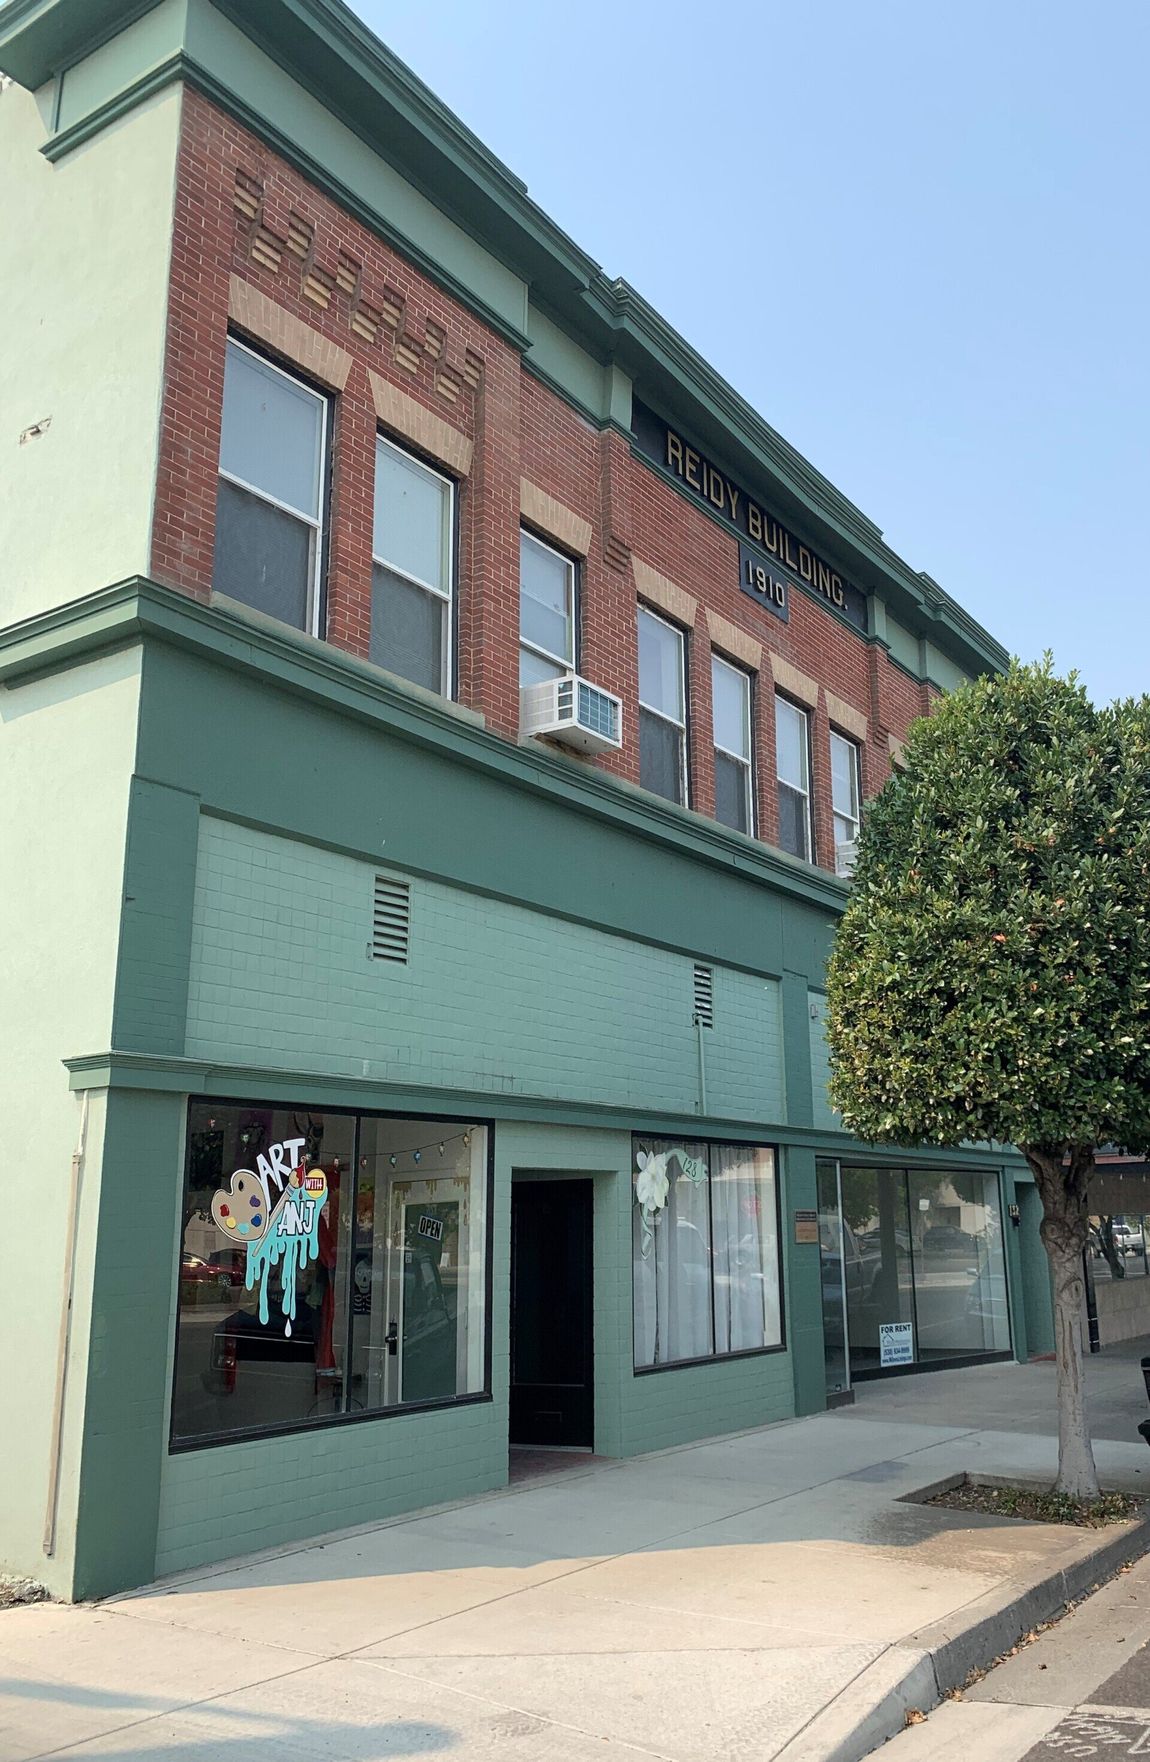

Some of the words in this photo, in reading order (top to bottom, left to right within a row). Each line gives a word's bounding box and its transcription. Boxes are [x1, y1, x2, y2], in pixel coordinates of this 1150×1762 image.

[667, 430, 739, 519] REIDY
[748, 560, 785, 607] 1910
[256, 1138, 306, 1212] ART
[683, 1157, 697, 1178] 128
[305, 1180, 323, 1190] WITH
[278, 1201, 316, 1236] ANJ
[420, 1217, 442, 1239] OPEN
[895, 1324, 911, 1332] RENT
